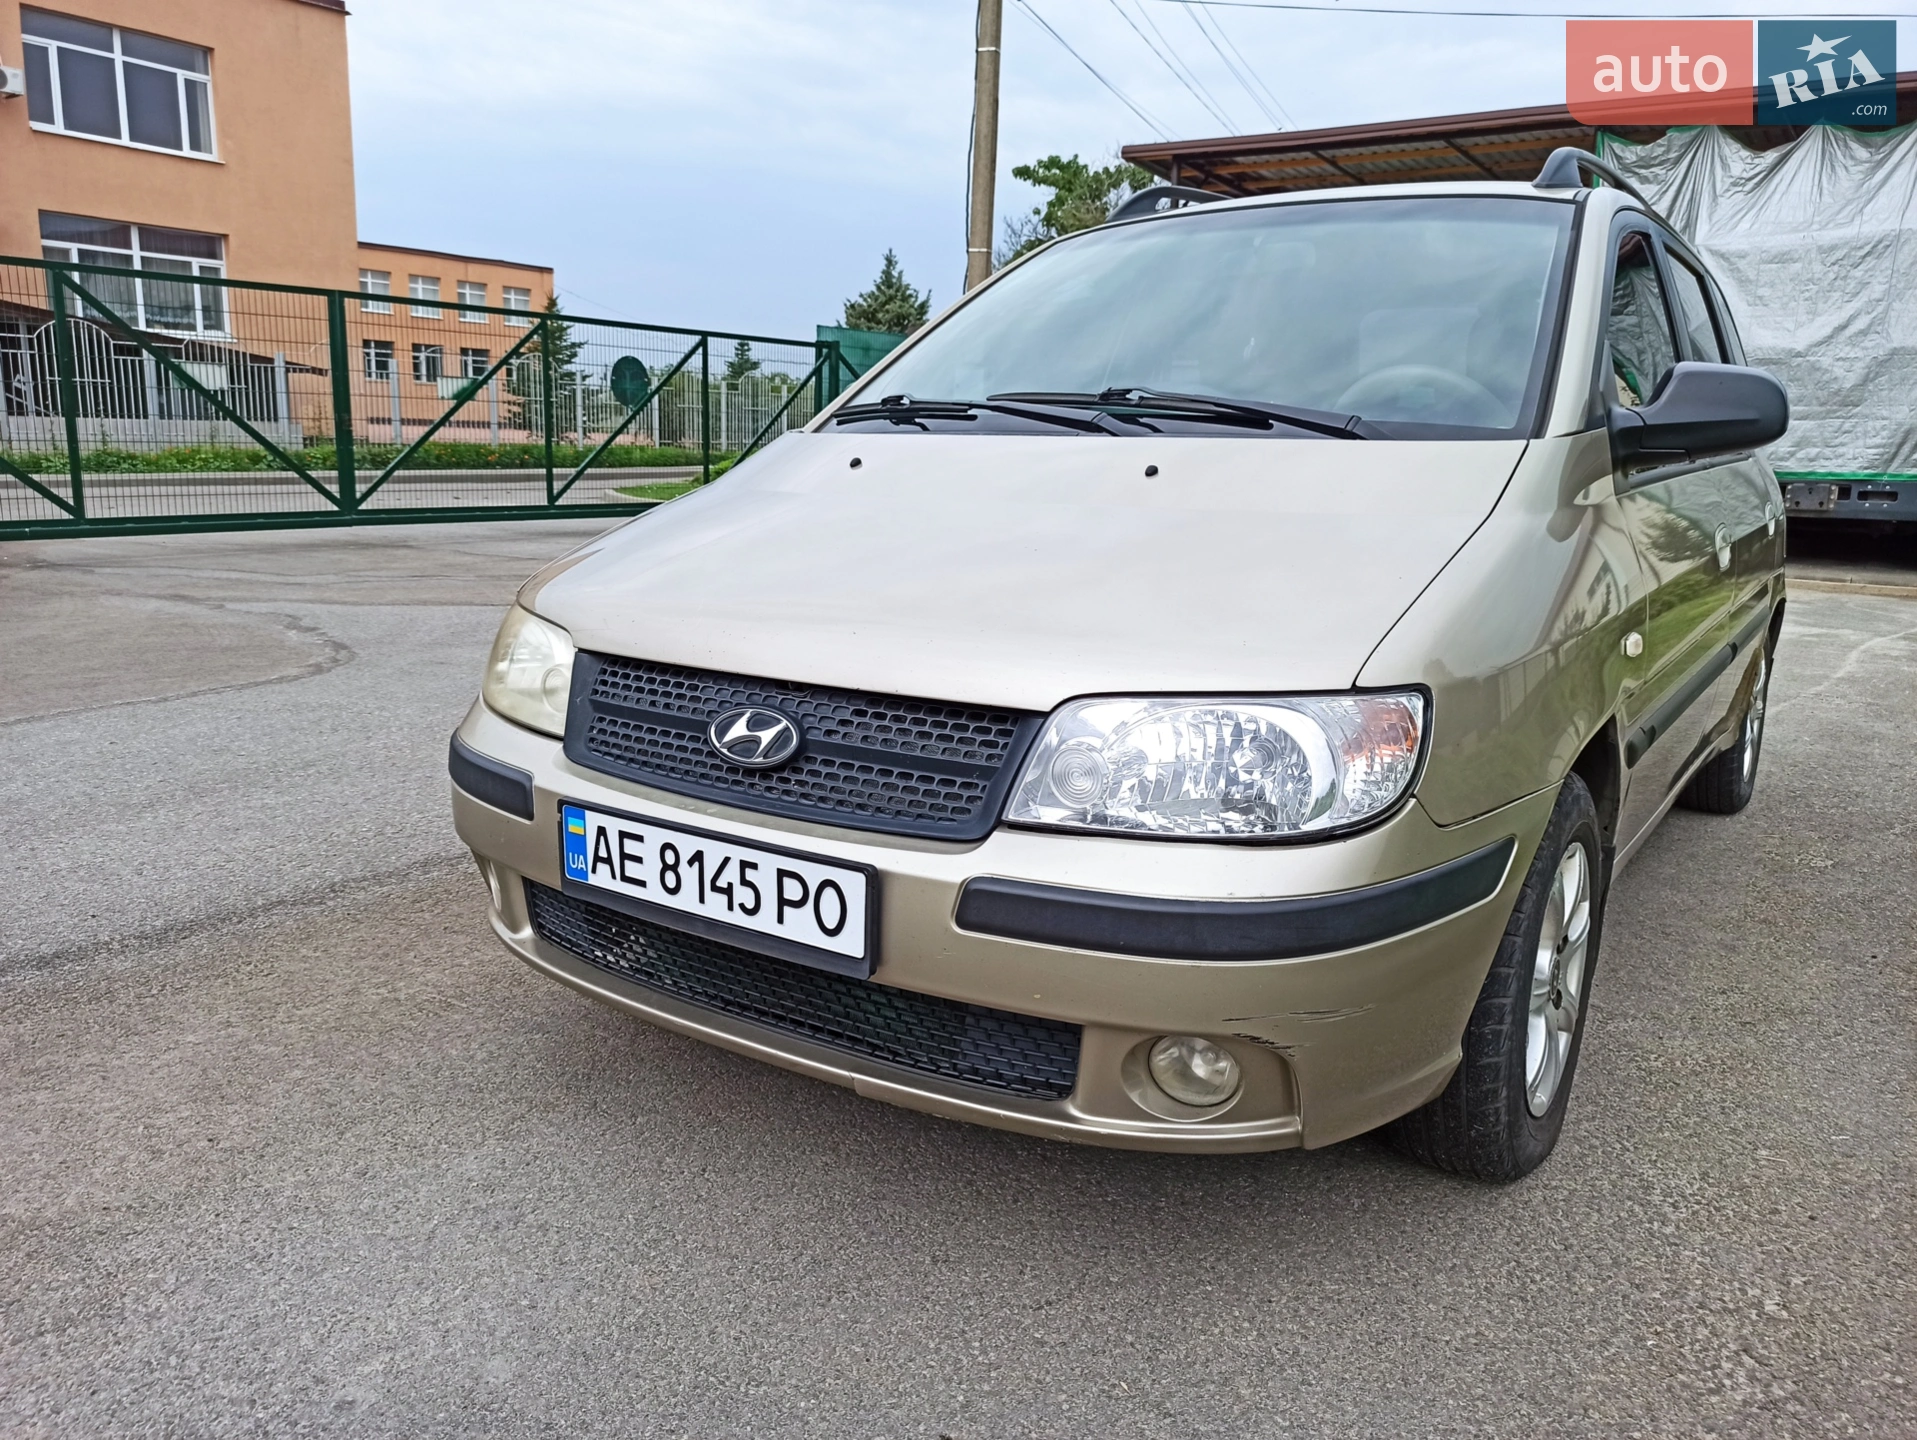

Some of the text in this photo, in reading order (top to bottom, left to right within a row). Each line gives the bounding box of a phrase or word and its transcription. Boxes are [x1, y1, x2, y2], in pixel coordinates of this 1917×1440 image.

[569, 852, 586, 872] UA
[591, 825, 847, 937] AE 8145 PO
